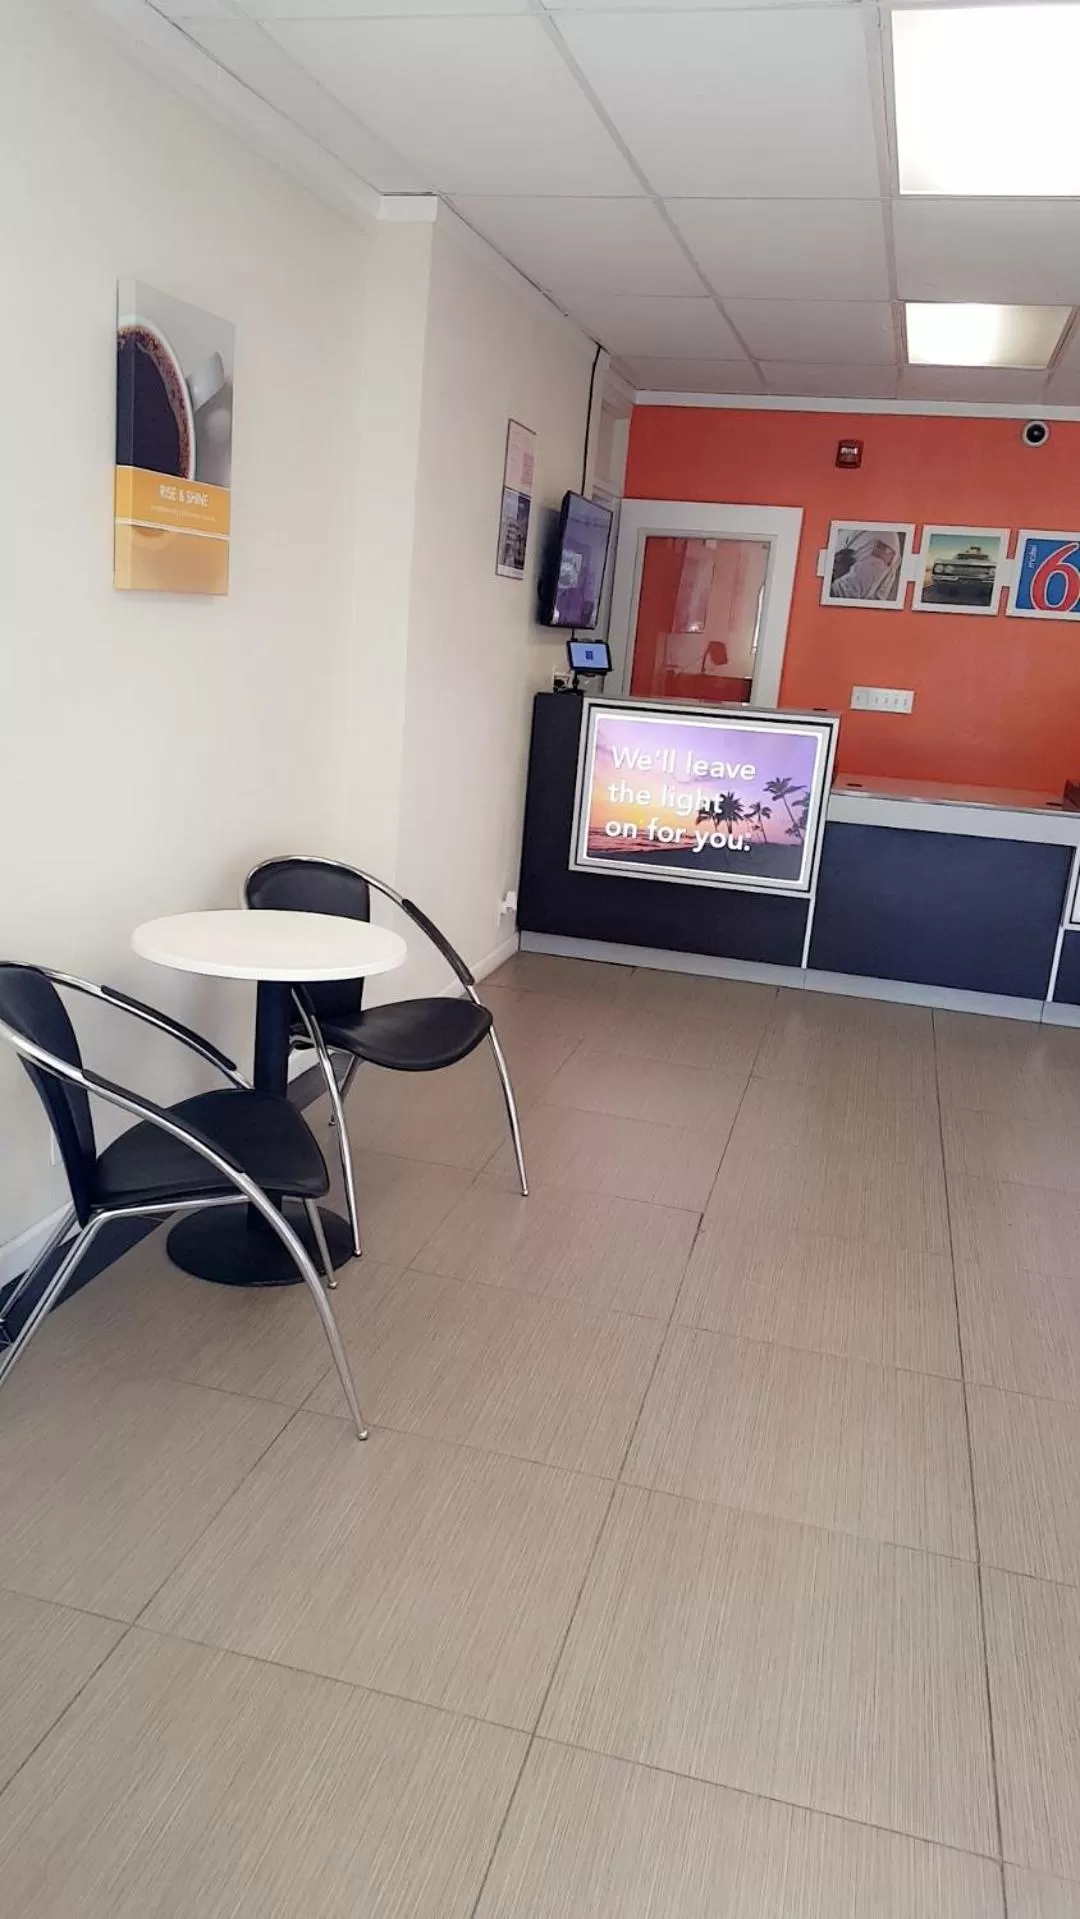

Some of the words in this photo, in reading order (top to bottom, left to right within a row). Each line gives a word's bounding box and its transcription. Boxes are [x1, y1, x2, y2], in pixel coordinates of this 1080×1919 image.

[1030, 542, 1080, 611] 6
[612, 745, 676, 773] We'll
[686, 750, 757, 780] leave
[607, 780, 651, 805] the
[661, 784, 724, 816] light
[605, 820, 638, 839] on
[647, 817, 687, 843] for
